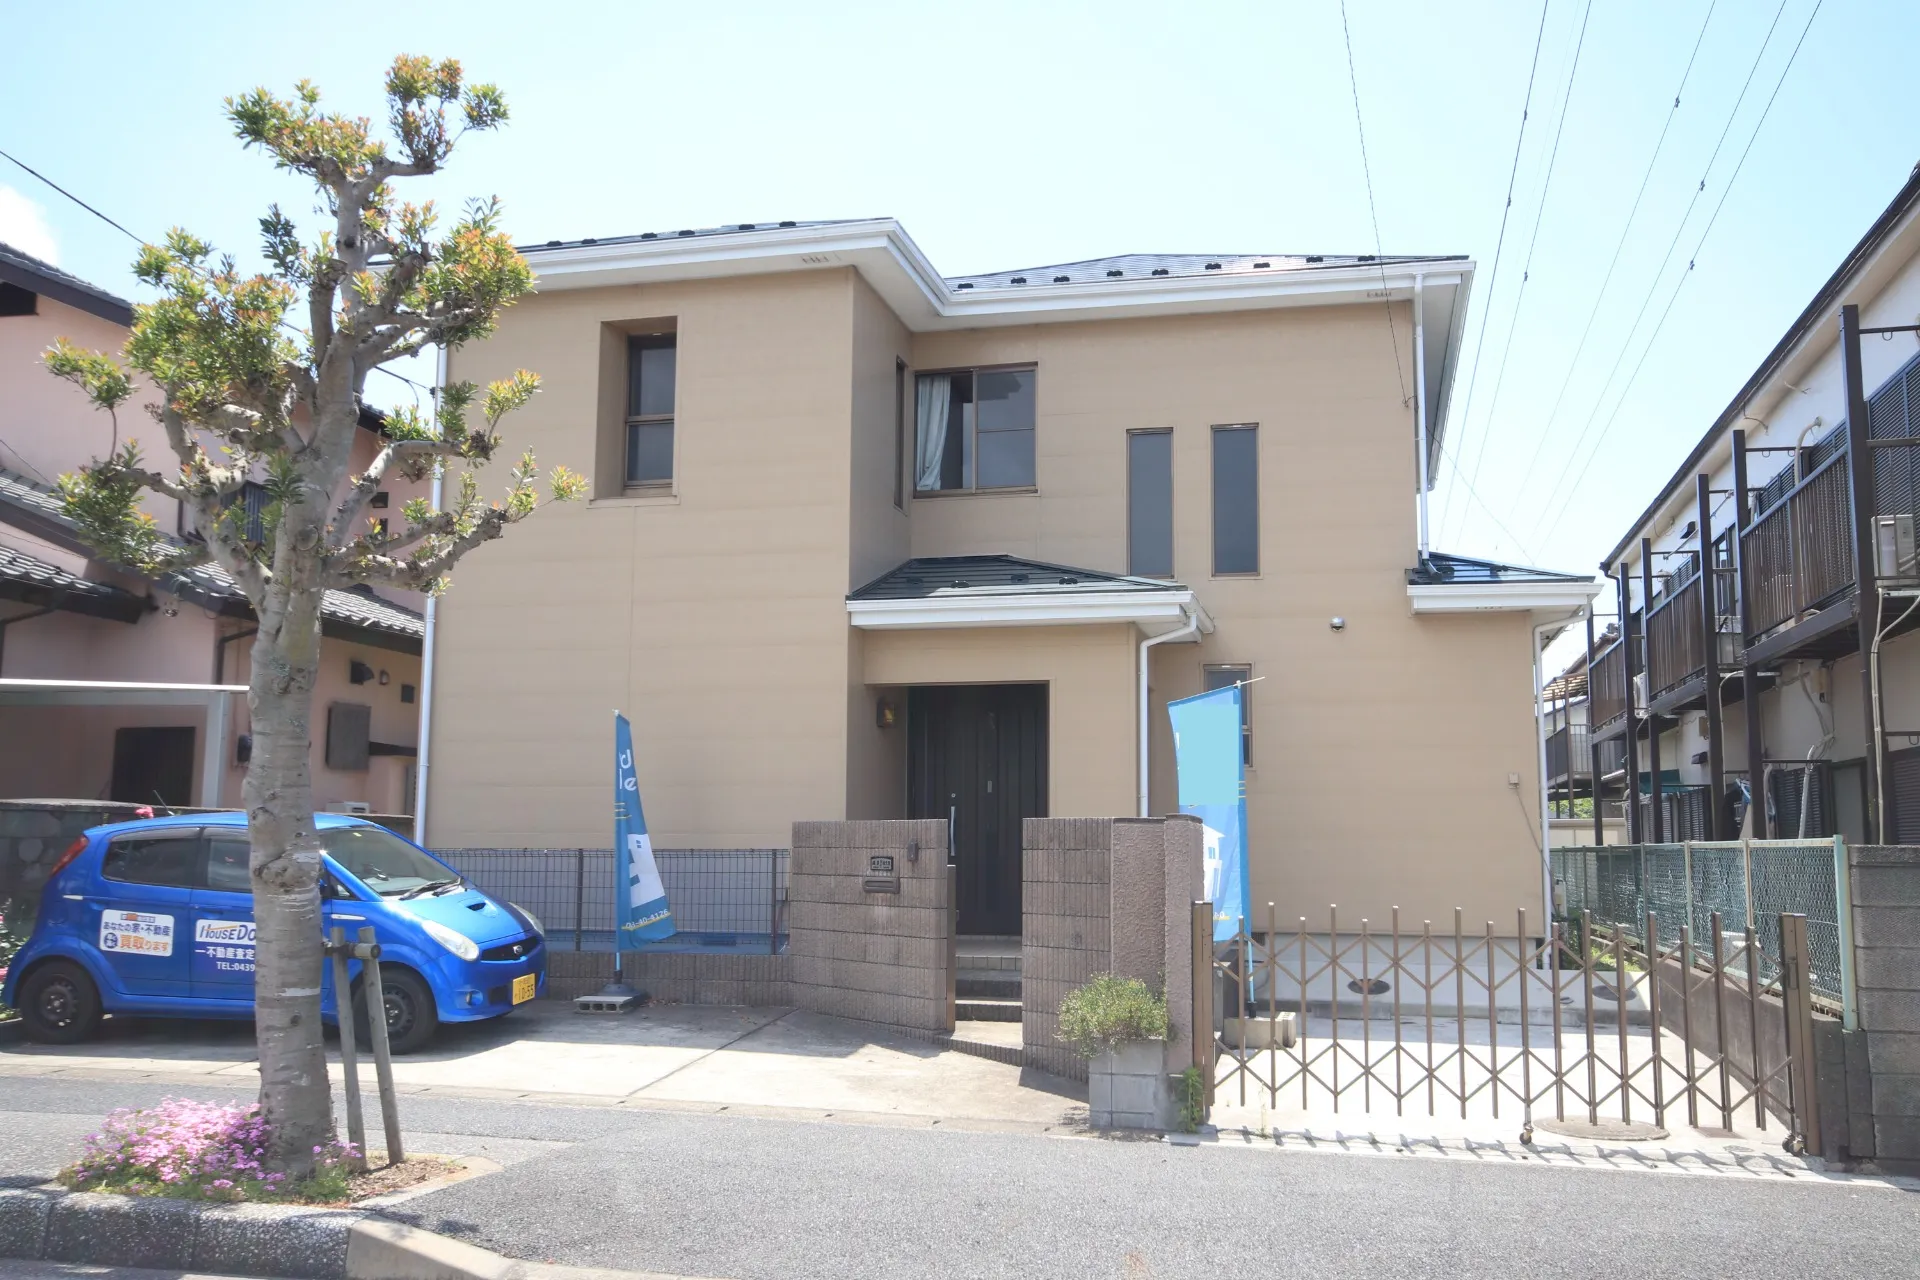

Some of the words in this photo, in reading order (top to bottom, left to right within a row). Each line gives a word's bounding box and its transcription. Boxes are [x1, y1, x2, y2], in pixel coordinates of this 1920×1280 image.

[103, 921, 172, 936] あなたの家・不動産
[120, 934, 169, 952] 買取ります
